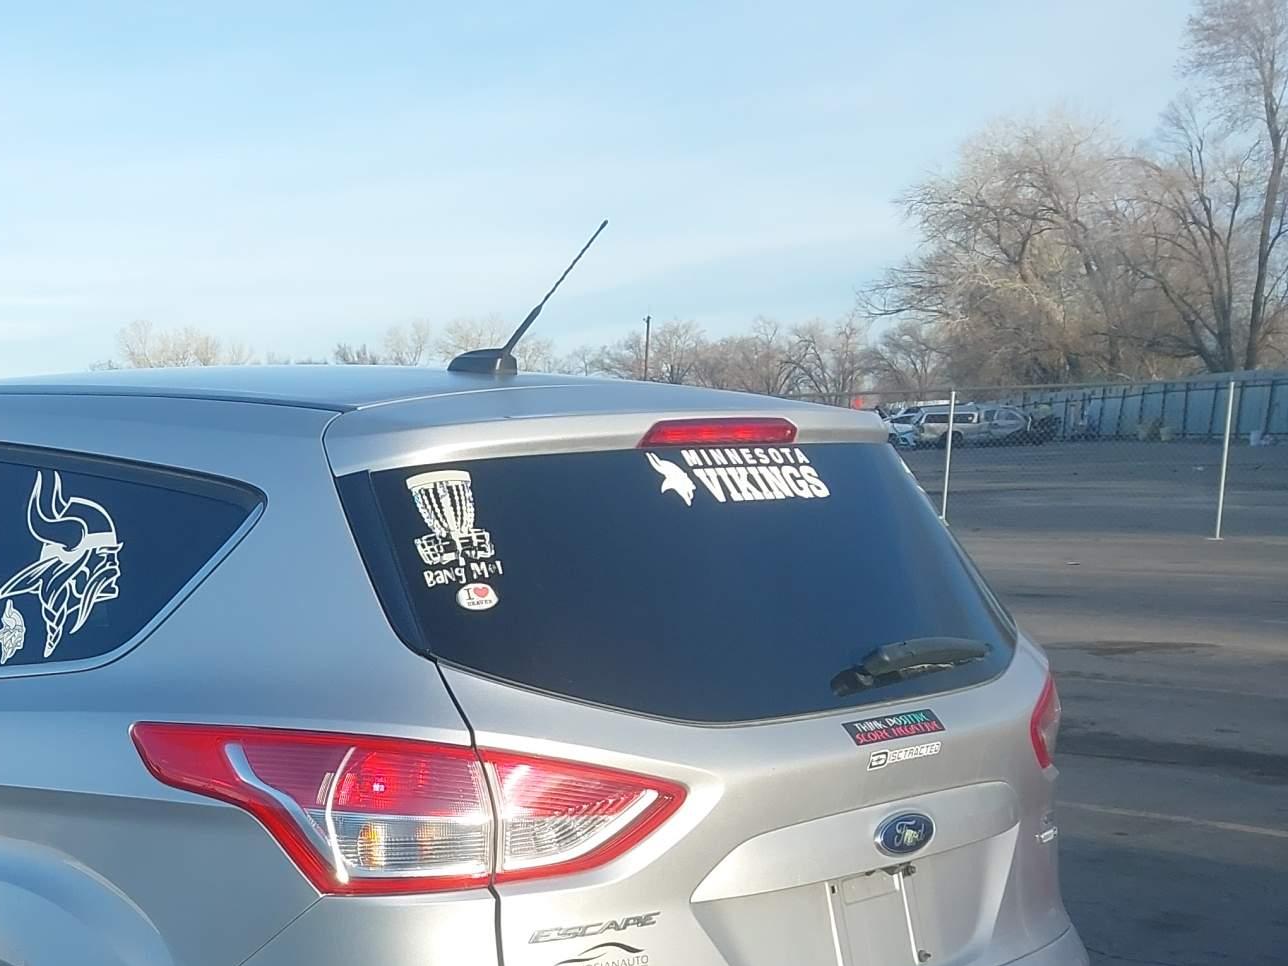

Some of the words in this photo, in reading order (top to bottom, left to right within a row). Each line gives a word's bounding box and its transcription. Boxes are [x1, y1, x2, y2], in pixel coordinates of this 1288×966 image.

[681, 448, 810, 466] MINNESOTA
[692, 465, 831, 502] VIKINGS
[853, 720, 887, 732] THINK
[885, 712, 929, 726] POSITIVE
[855, 730, 890, 744] SCORE
[892, 720, 941, 736] NEGATIVE
[894, 820, 926, 847] Ford
[528, 911, 661, 944] ESCAPE
